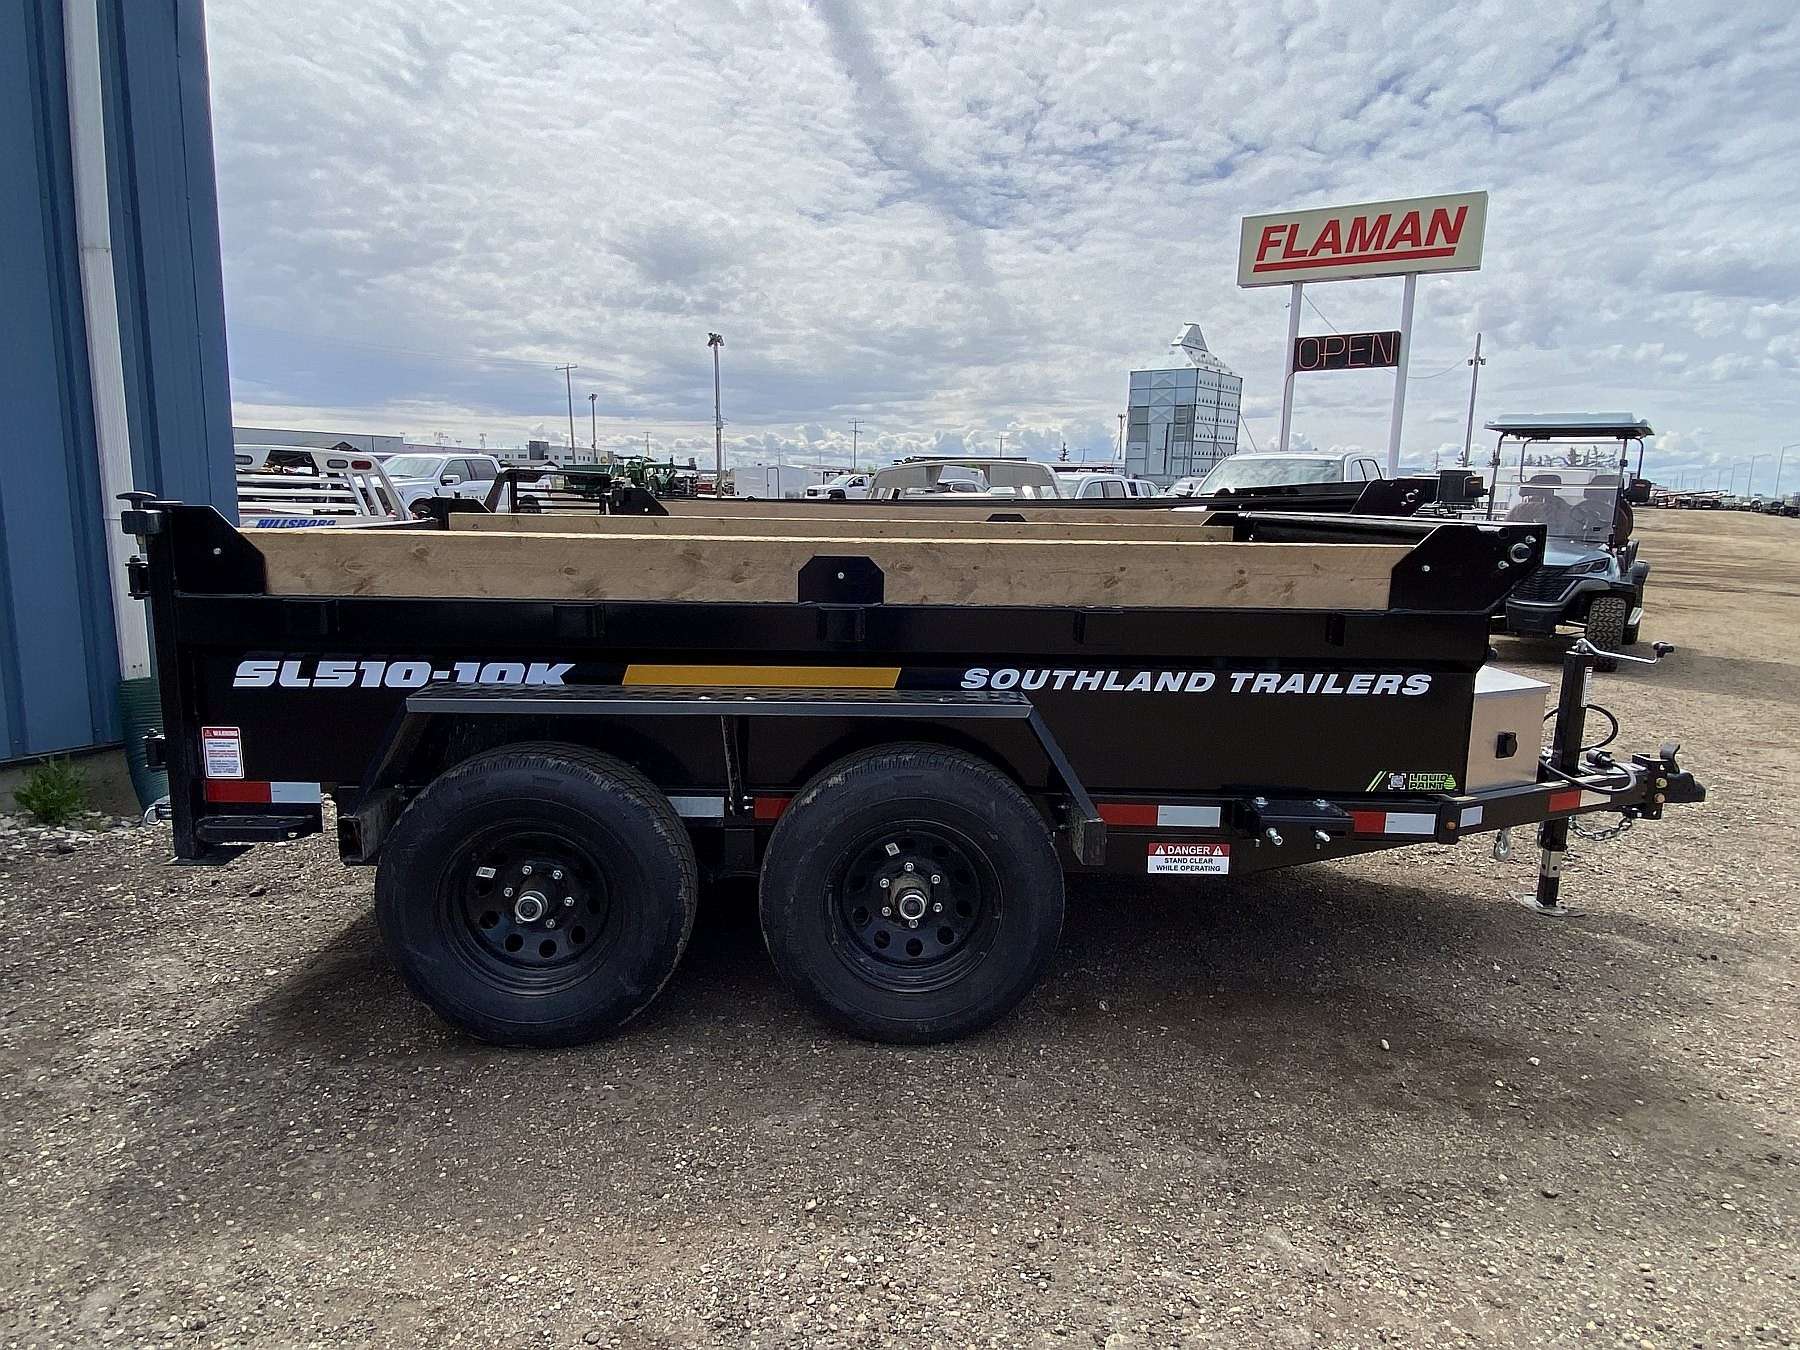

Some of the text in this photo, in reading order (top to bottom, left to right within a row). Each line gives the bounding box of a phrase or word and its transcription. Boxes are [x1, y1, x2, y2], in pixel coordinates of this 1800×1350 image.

[1256, 206, 1469, 262] FLAMAN
[1298, 332, 1395, 369] OPEN
[233, 660, 575, 688] SL510-10K
[960, 668, 1432, 696] SOUTHLAND TRAILERS
[1409, 781, 1444, 790] PAINT
[1410, 773, 1448, 782] LIQUID
[1167, 845, 1210, 855] DANGER
